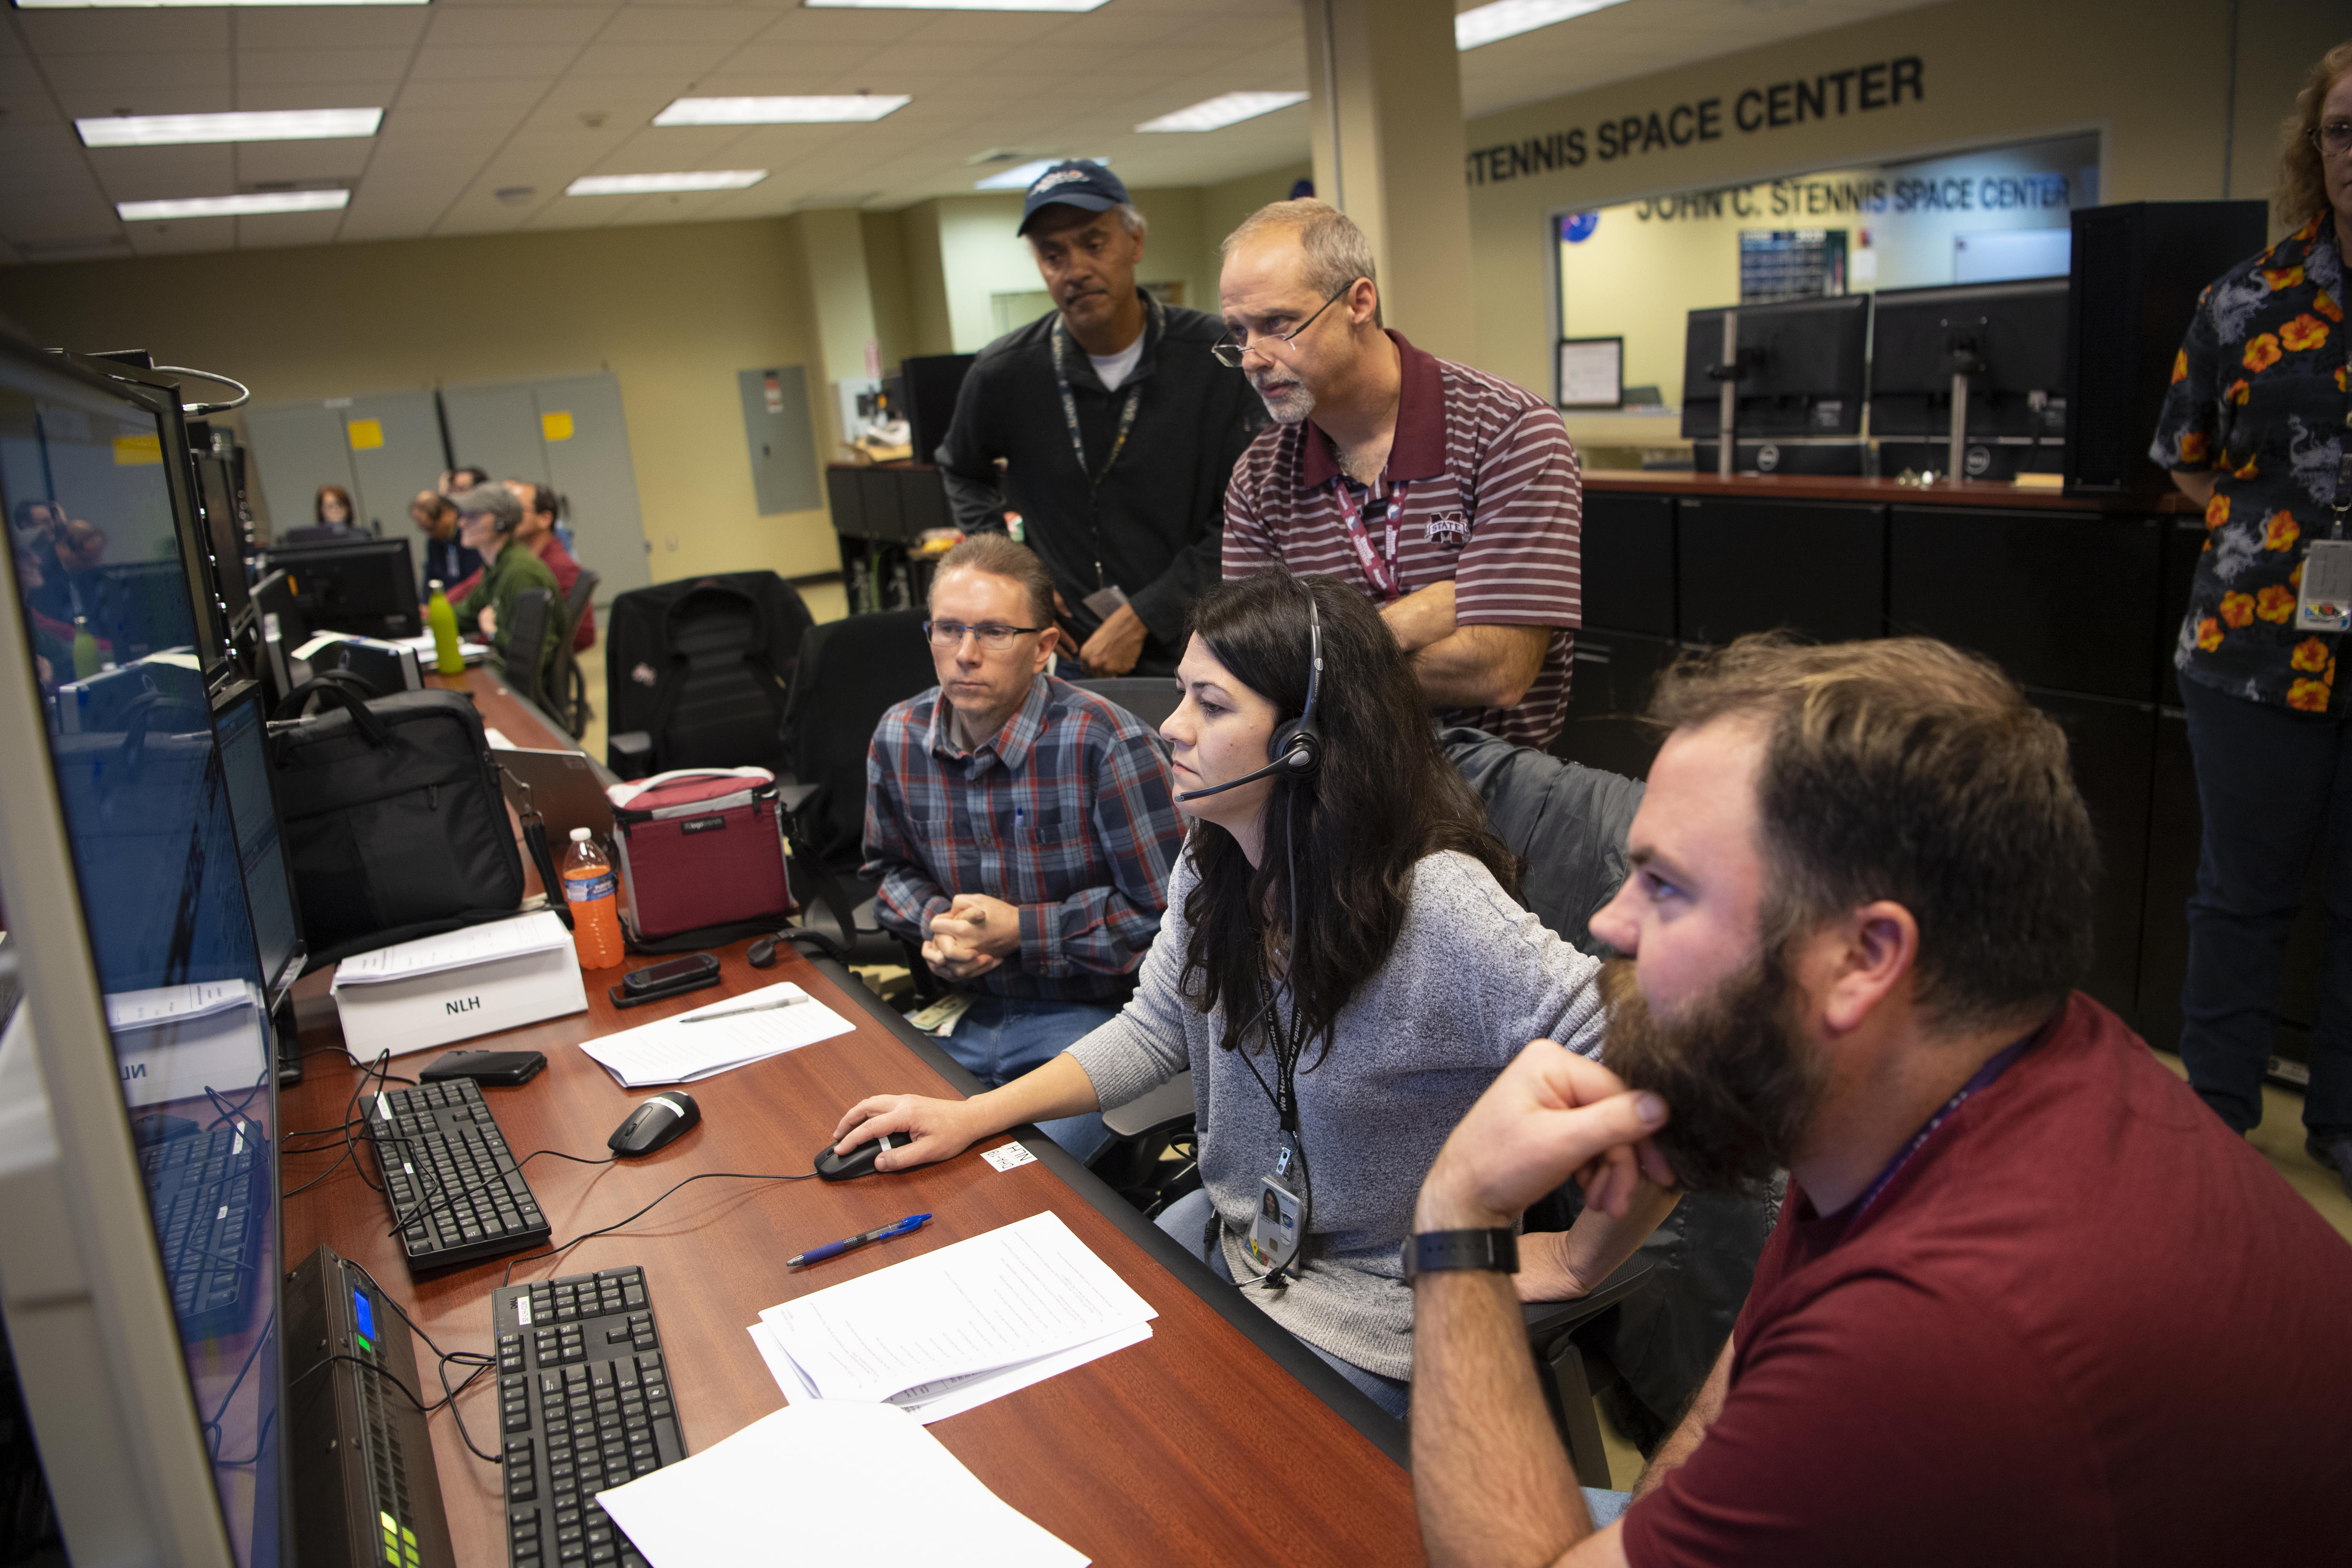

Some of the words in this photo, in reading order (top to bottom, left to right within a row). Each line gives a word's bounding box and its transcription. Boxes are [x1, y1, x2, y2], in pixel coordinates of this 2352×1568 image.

[1597, 96, 1721, 160] SPACE
[1735, 55, 1923, 132] CENTER
[1771, 178, 1886, 215] STENNIS
[1894, 177, 1974, 212] SPACE
[1979, 175, 2069, 210] CENTER
[1432, 522, 1461, 532] STATE
[446, 996, 480, 1015] NLH
[1268, 1011, 1273, 1021] In
[1270, 1025, 1282, 1063] Friends
[1291, 1044, 1297, 1054] In
[1279, 1096, 1287, 1111] We
[987, 1150, 1014, 1169] DHA-19
[1007, 1145, 1032, 1161] NLH
[509, 1296, 518, 1309] DELL
